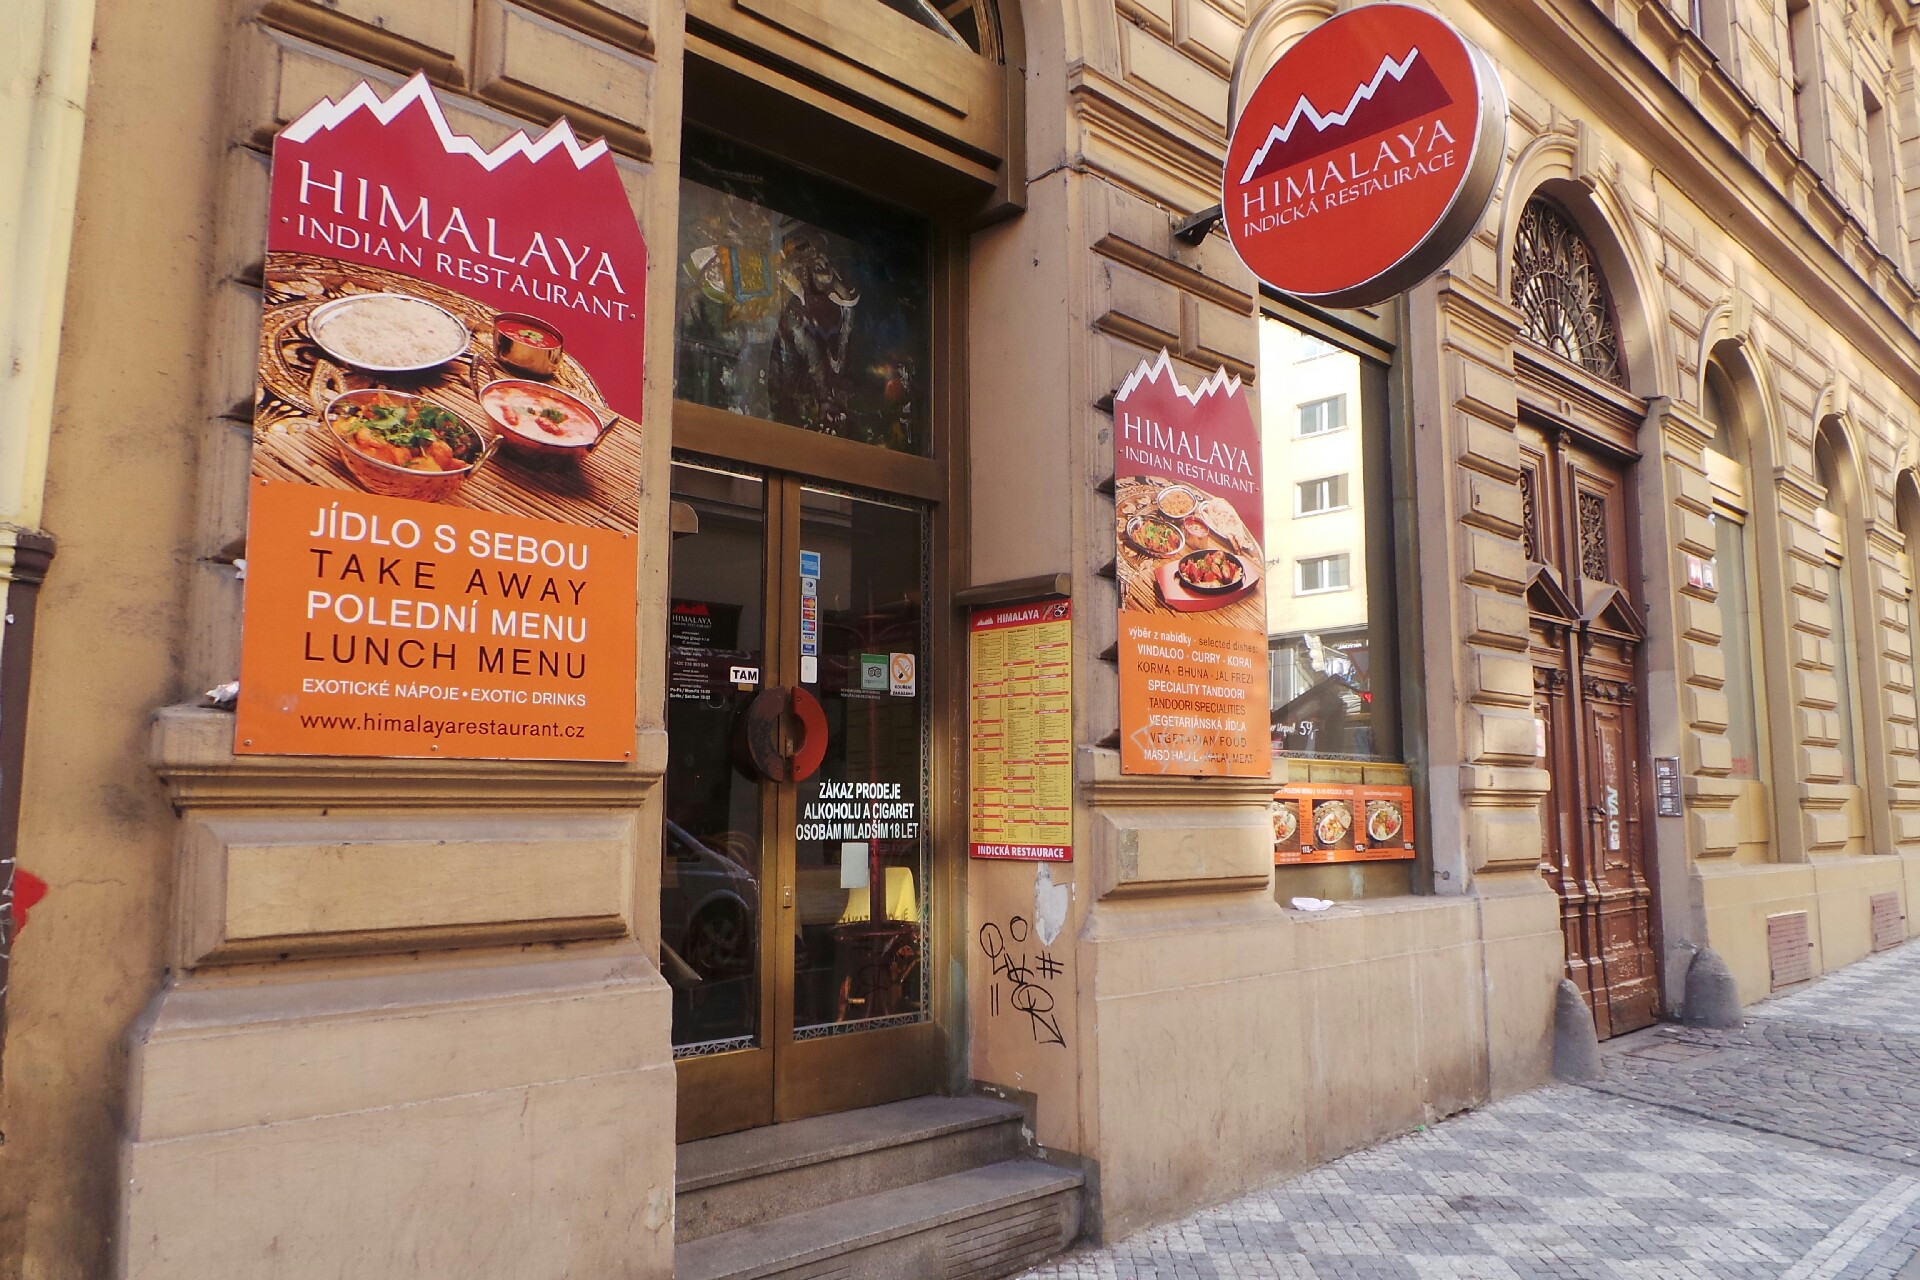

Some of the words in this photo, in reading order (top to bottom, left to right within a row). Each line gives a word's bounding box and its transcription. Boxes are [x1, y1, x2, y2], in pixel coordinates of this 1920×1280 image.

[1242, 119, 1457, 218] HIMALAYA
[1243, 197, 1320, 238] INDICKÁ
[1324, 149, 1456, 210] RESTAURACE
[298, 159, 627, 295] HIMALAYA
[298, 213, 423, 269] INDIAN
[436, 253, 630, 322] RESTAURANT
[1123, 412, 1254, 477] HIMALAYA
[1125, 445, 1173, 472] INDIAN
[1176, 461, 1256, 494] RESTAURANT
[308, 501, 421, 550] JÍDLO
[433, 524, 457, 554] S
[468, 528, 589, 571] SEBOU
[309, 548, 437, 591] TAKE
[465, 567, 588, 606] AWAY
[306, 590, 479, 634] POLEDNÍ
[491, 608, 587, 644] MENU
[672, 614, 712, 625] HIMALAYA
[996, 609, 1040, 624] HIMALAYA
[1128, 625, 1152, 640] výběr
[1153, 631, 1159, 640] z
[1160, 632, 1192, 647] nabídky
[1198, 637, 1231, 650] selected
[304, 631, 457, 671] LUNCH
[478, 645, 586, 679] MENU
[1137, 643, 1184, 660] VINDALOO
[1191, 650, 1221, 665] CURRY
[1227, 655, 1252, 669] KORAI
[732, 669, 758, 681] TAM
[1137, 661, 1171, 675] KORMA
[1177, 665, 1209, 679] BHUNA
[1215, 670, 1229, 682] JAL
[302, 678, 390, 697] EXOTICKÉ
[395, 682, 459, 701] NÁPOJE
[471, 687, 528, 706] EXOTIC
[531, 691, 586, 708] DRINKS
[1148, 679, 1200, 696] SPECIALITY
[1201, 684, 1246, 700] TANDOORI
[1149, 697, 1193, 711] TANDOORI
[1194, 701, 1246, 716] SPECIALITIES
[300, 712, 585, 739] www.himalayarestaurant.cz
[1149, 714, 1223, 731] VEGETARIÁNSKÁ
[1220, 736, 1247, 748] FOOD
[1144, 749, 1170, 761] MASO
[819, 779, 854, 799] ZÁKAZ
[855, 782, 901, 799] PRODEJE
[803, 802, 861, 820] ALKOHOLU
[863, 803, 871, 819] A
[872, 802, 915, 819] CIGARET
[795, 820, 842, 840] OSOBÁM
[843, 820, 889, 840] MLADŠÍM
[889, 823, 900, 839] 18
[901, 823, 919, 839] LET
[977, 844, 1010, 856] INDICKÁ
[1011, 846, 1064, 858] RESTAURACE
